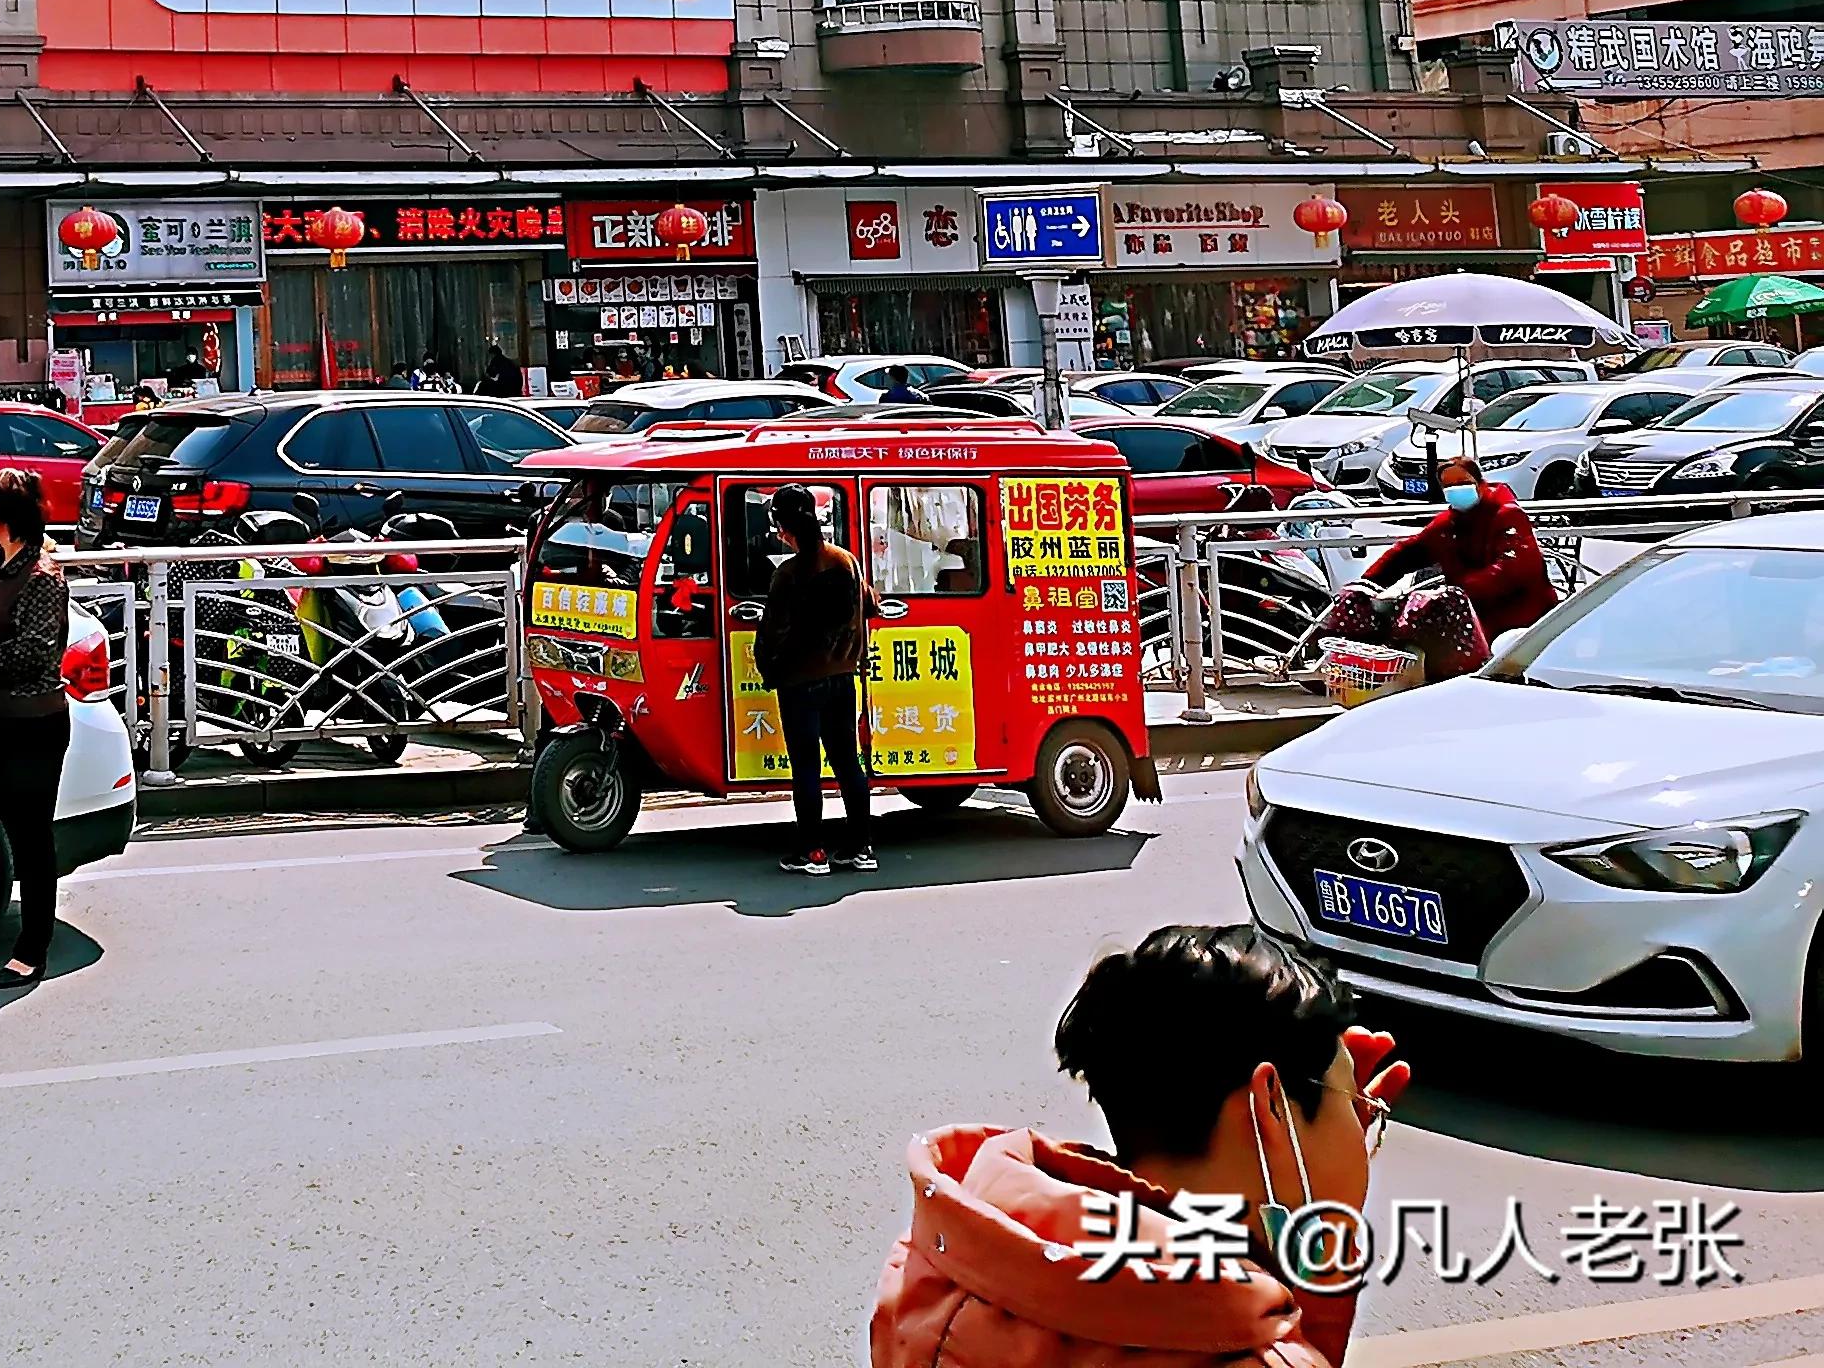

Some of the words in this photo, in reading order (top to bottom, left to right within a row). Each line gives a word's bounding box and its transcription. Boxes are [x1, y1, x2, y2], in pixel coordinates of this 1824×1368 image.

[1565, 25, 1721, 72] 精武国术馆
[1377, 198, 1461, 227] 老人头
[591, 209, 735, 249] 正新排
[1498, 327, 1574, 342] HAJACK
[1007, 481, 1119, 532] 出国劳务
[1010, 535, 1121, 560] 胶州蓝丽
[1022, 585, 1099, 612] 鼻祖堂
